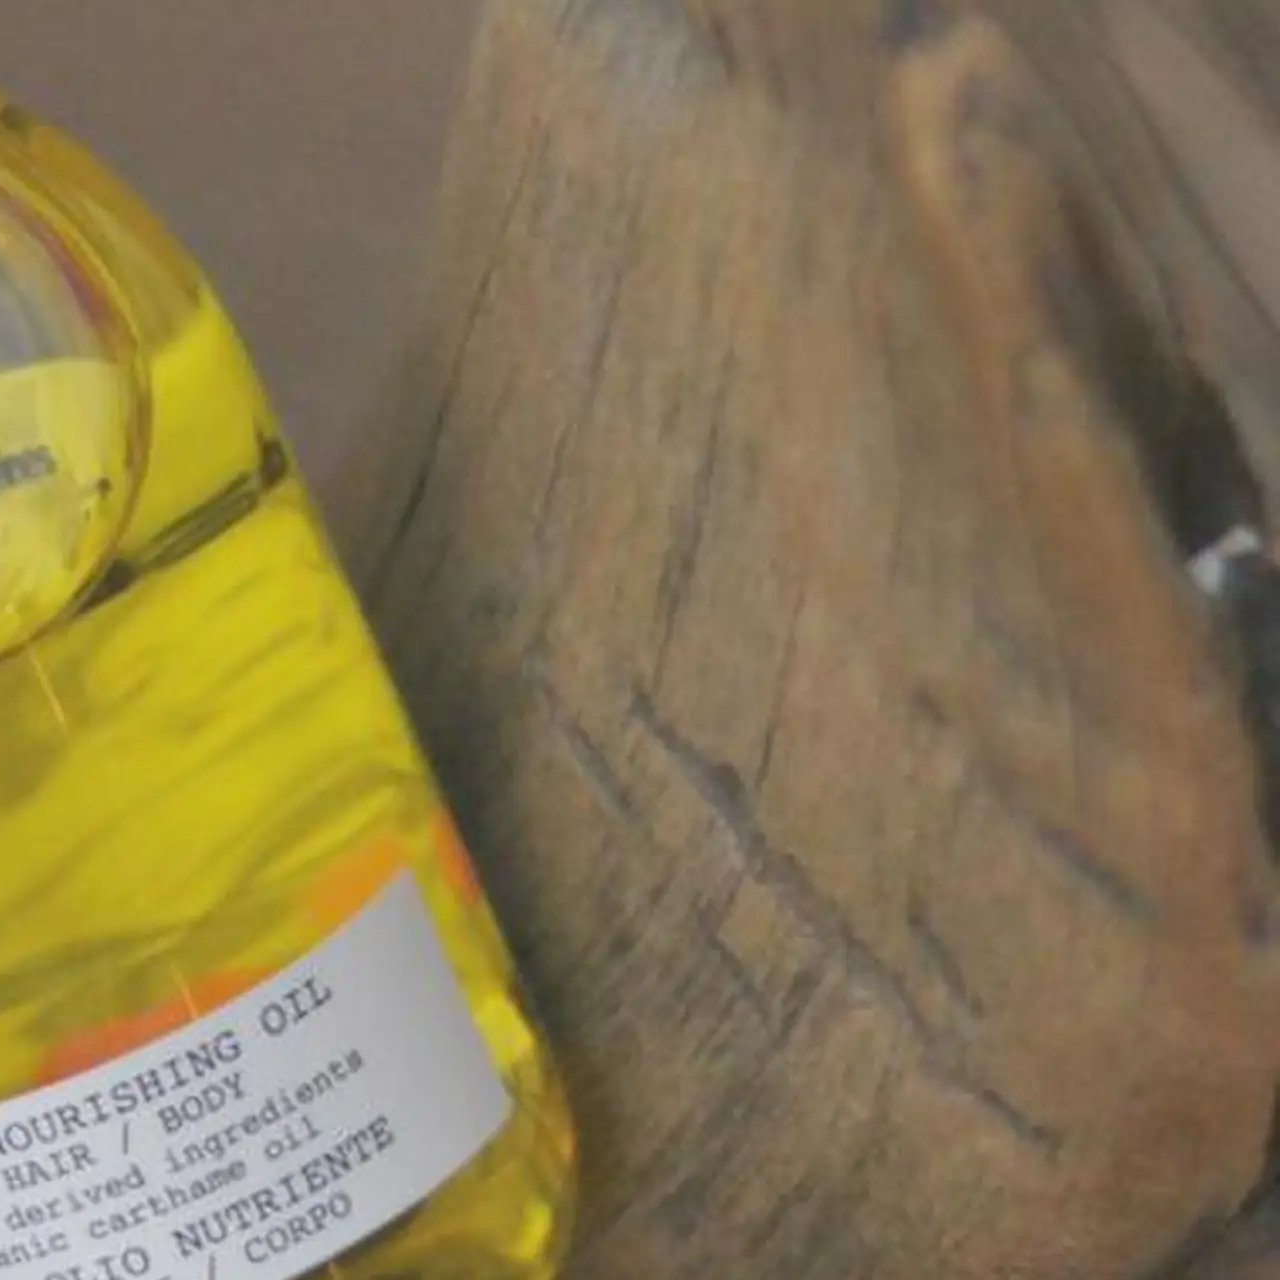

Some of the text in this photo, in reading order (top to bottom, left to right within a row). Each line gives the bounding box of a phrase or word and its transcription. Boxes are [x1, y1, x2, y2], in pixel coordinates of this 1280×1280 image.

[254, 971, 334, 1039] OIL
[2, 1144, 97, 1194] HAIR
[119, 1122, 133, 1153] /
[157, 1070, 245, 1135] BODY
[3, 1162, 147, 1235] derived
[163, 1047, 367, 1173] ingredients
[86, 1161, 249, 1241] carthame
[262, 1114, 321, 1161] oil
[173, 1114, 398, 1258] NUTRIENTE
[241, 1189, 354, 1265] CORPO
